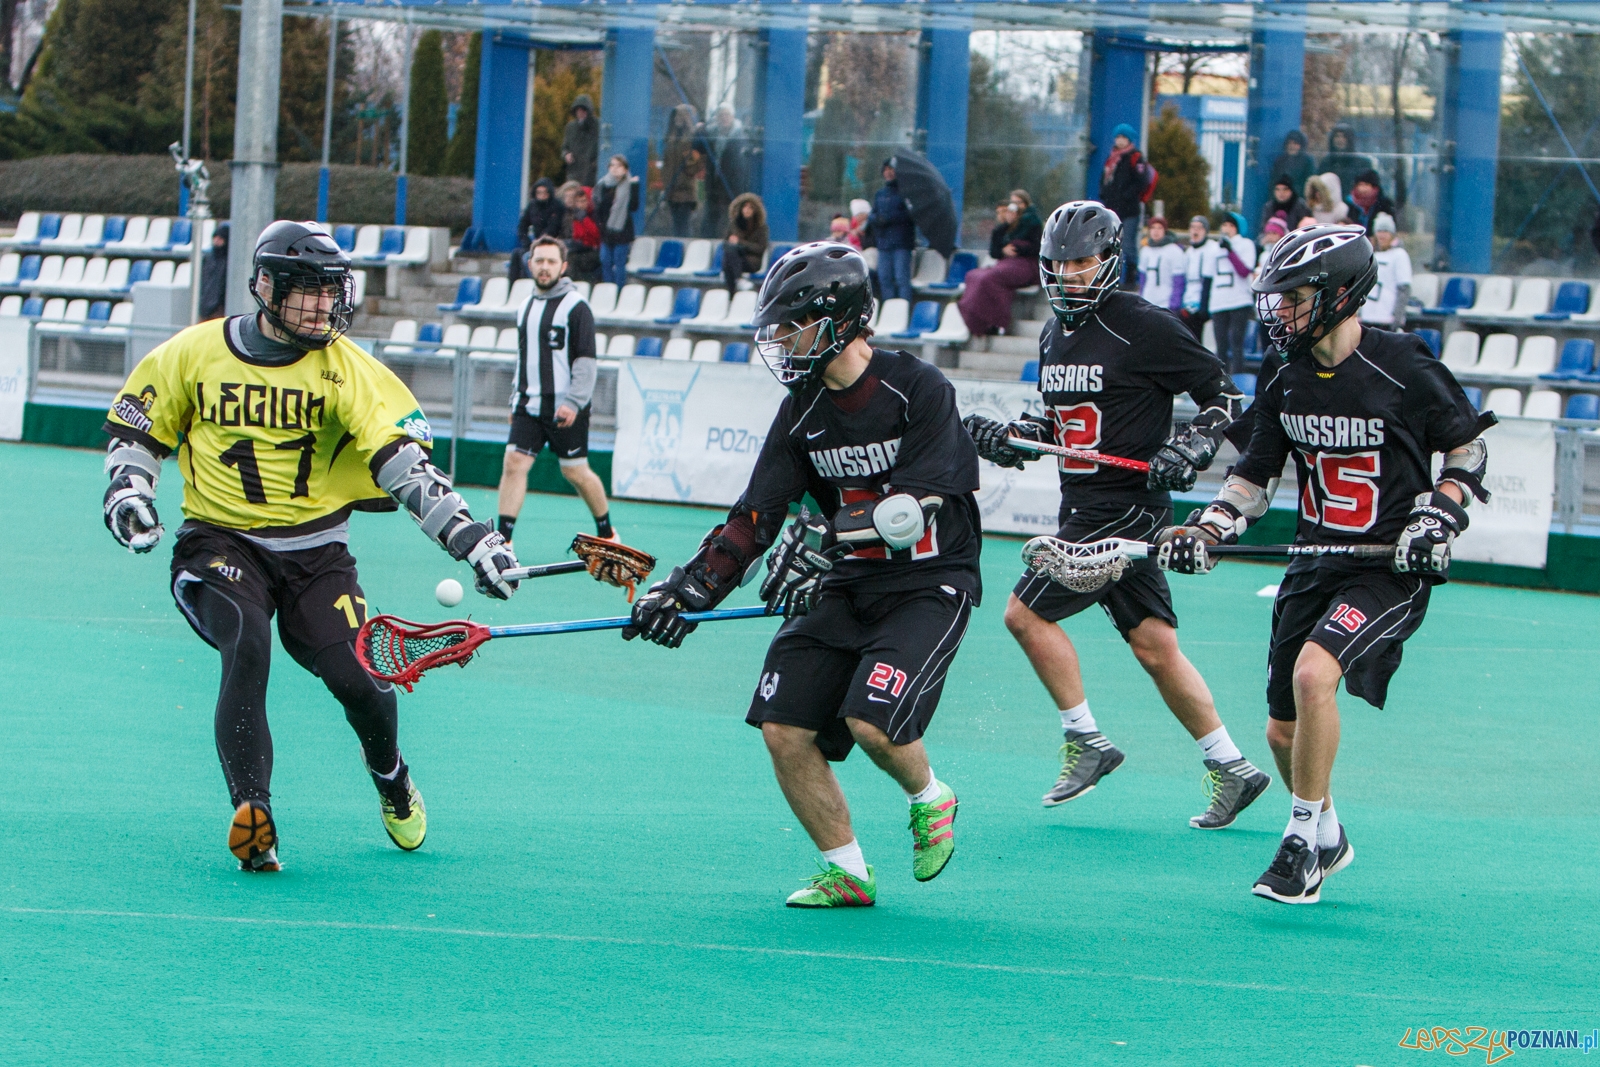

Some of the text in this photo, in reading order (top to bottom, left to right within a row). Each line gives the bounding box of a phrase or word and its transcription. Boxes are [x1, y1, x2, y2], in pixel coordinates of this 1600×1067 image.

[1041, 364, 1104, 393] USSARS
[197, 382, 326, 429] LEGION
[1279, 412, 1385, 447] HUSSARS
[218, 431, 317, 504] 17
[1295, 447, 1381, 533] 15
[1329, 603, 1368, 634] 15
[866, 662, 908, 698] 21
